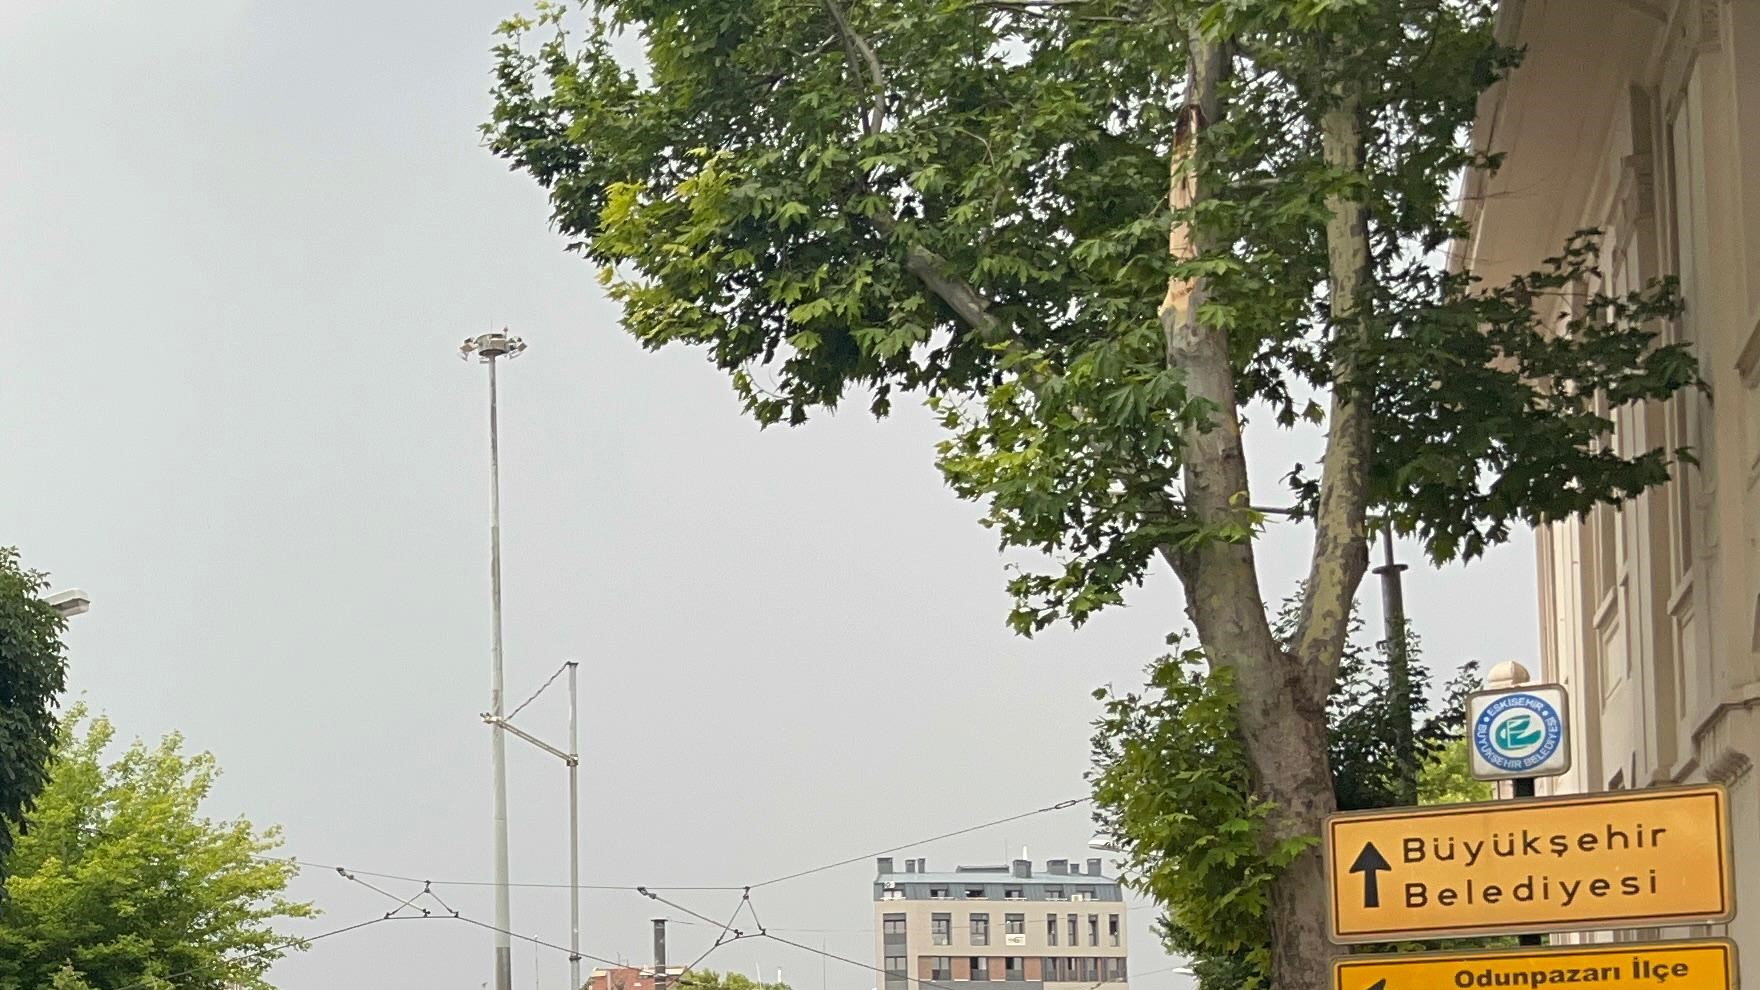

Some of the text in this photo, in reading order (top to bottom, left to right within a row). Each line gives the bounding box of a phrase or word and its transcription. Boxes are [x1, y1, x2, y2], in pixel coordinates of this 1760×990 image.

[1403, 824, 1667, 867] Büyükşehir
[1405, 869, 1658, 908] Belediyesi
[1455, 957, 1690, 989] Odunpazarı İlçe
